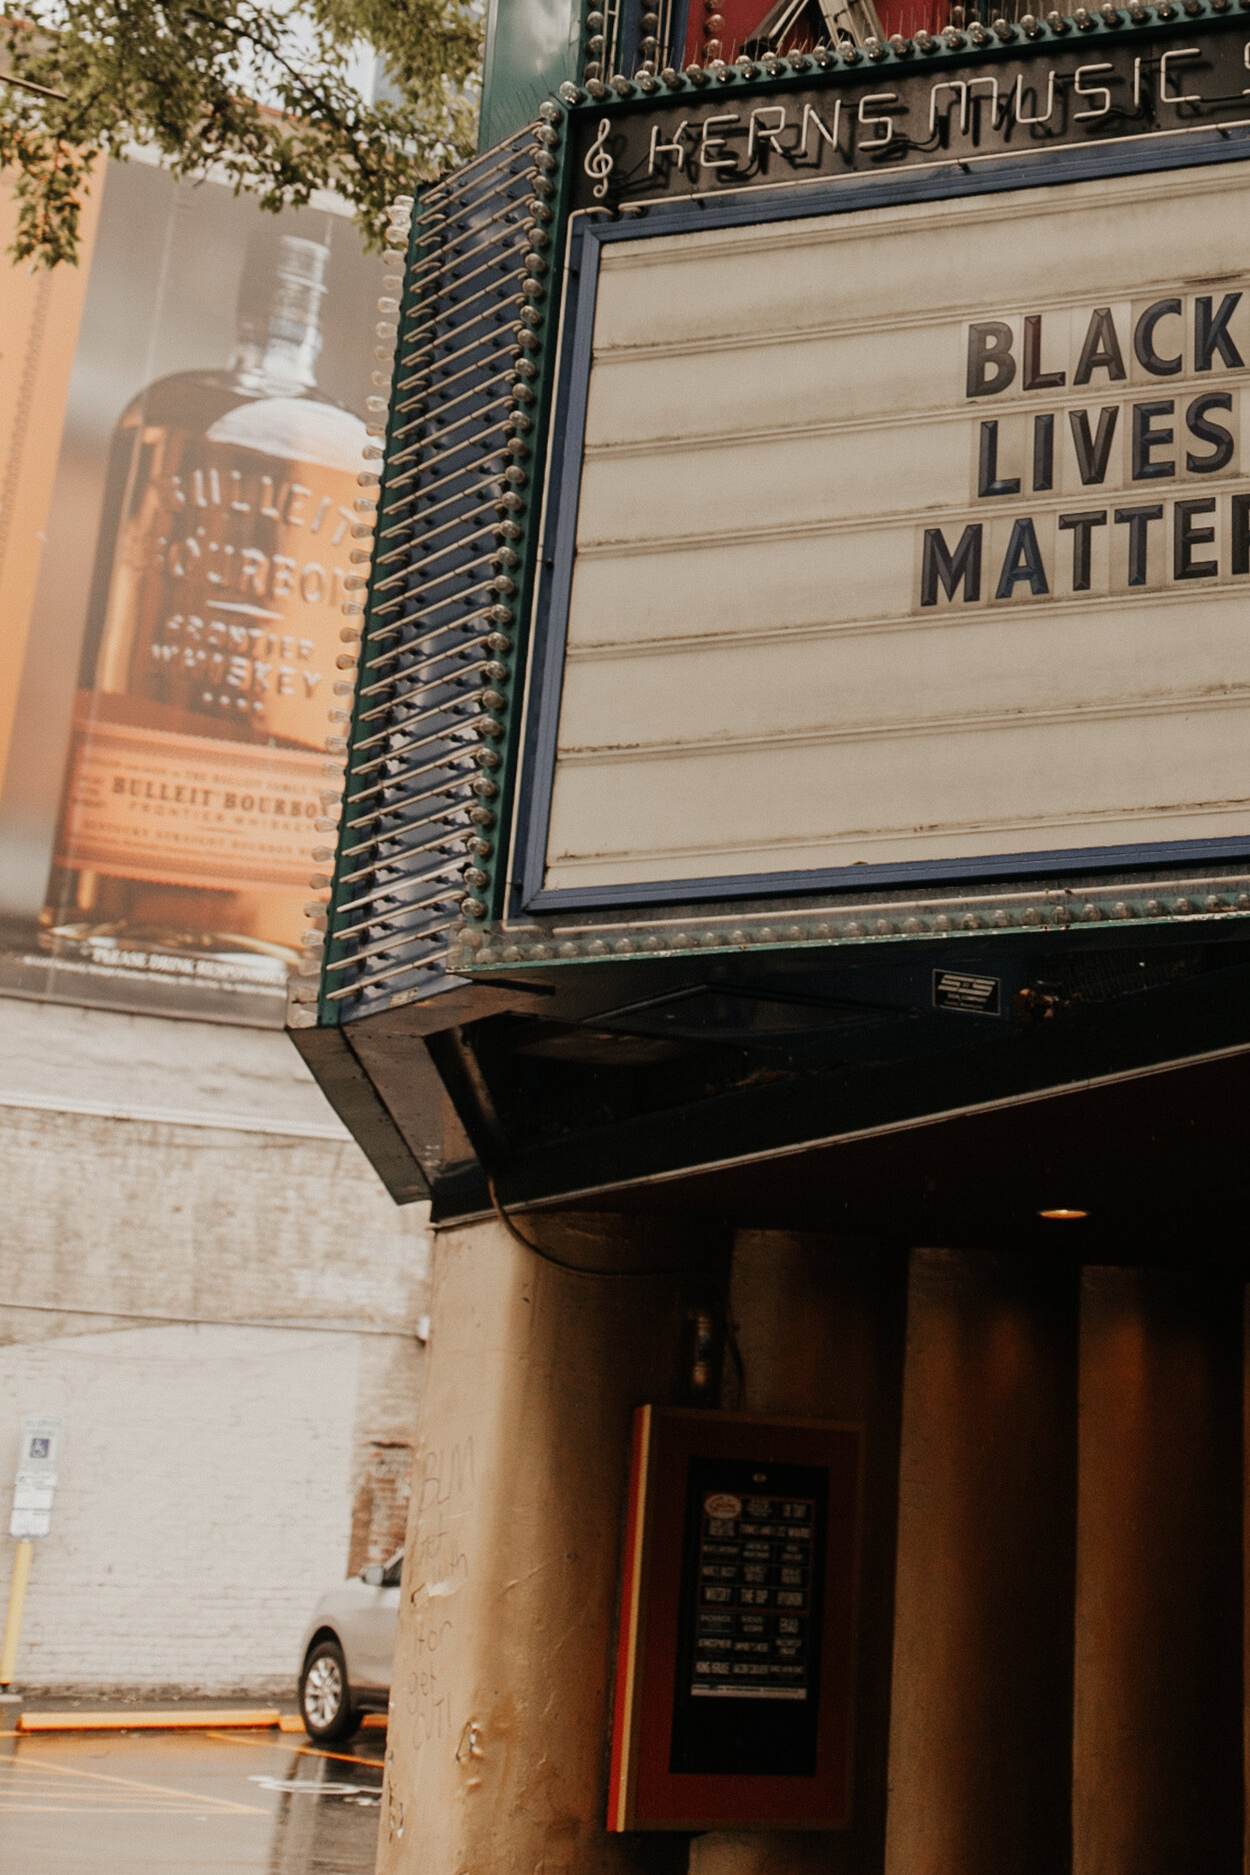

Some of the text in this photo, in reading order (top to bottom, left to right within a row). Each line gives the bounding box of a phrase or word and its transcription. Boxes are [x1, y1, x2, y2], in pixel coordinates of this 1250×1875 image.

[647, 94, 896, 178] KERNS
[929, 47, 1202, 133] MUSIC
[966, 291, 1246, 398] BLACK
[977, 391, 1235, 498] LIVES
[112, 775, 212, 808] BULLEIT
